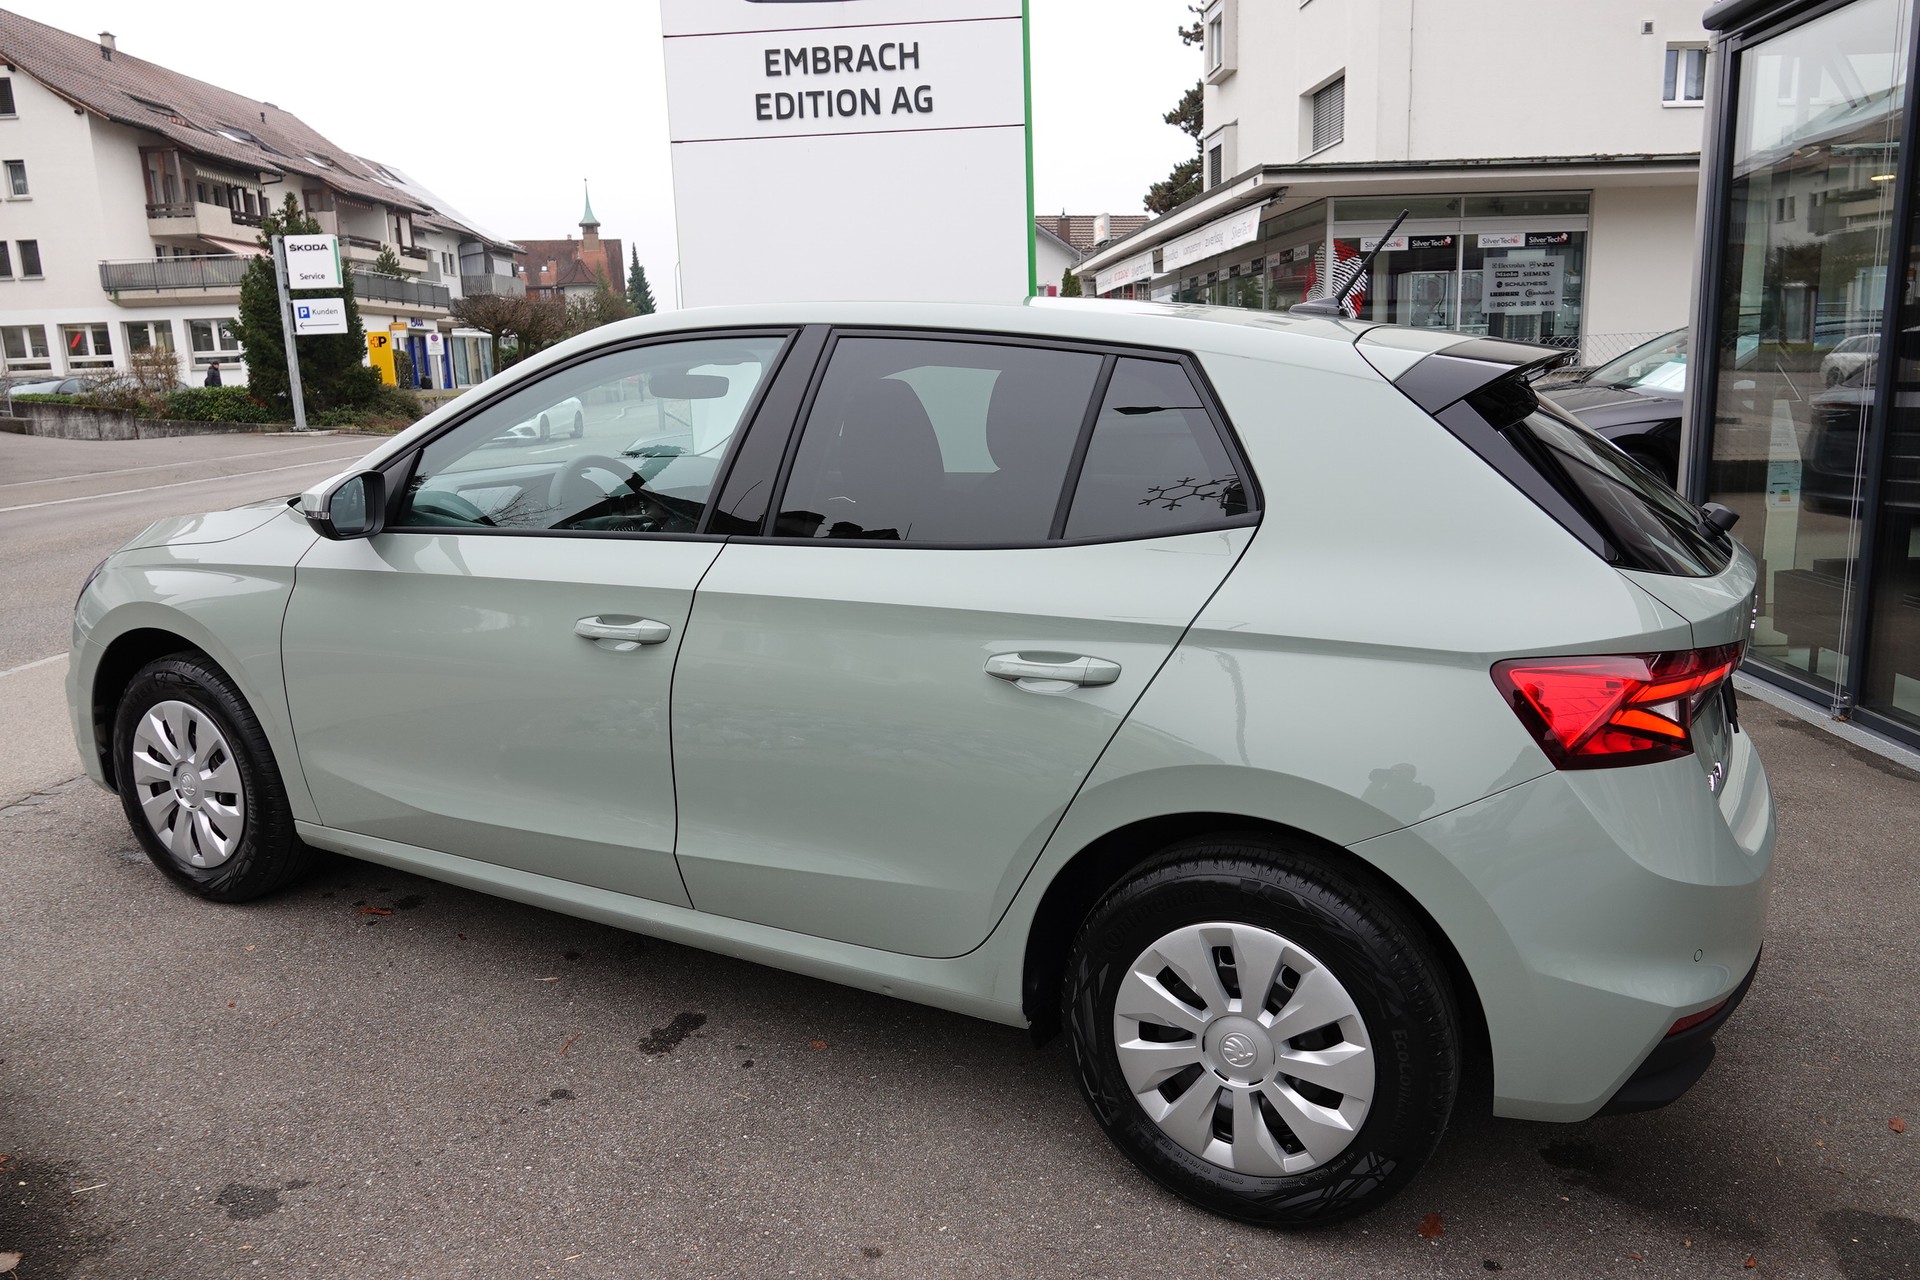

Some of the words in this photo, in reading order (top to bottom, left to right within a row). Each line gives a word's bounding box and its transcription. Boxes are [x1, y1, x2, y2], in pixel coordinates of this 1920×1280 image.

[764, 42, 920, 77] EMBRACH
[755, 87, 882, 121] EDITION
[891, 85, 934, 115] AG
[289, 243, 328, 252] ŠKODA
[299, 272, 326, 281] Service
